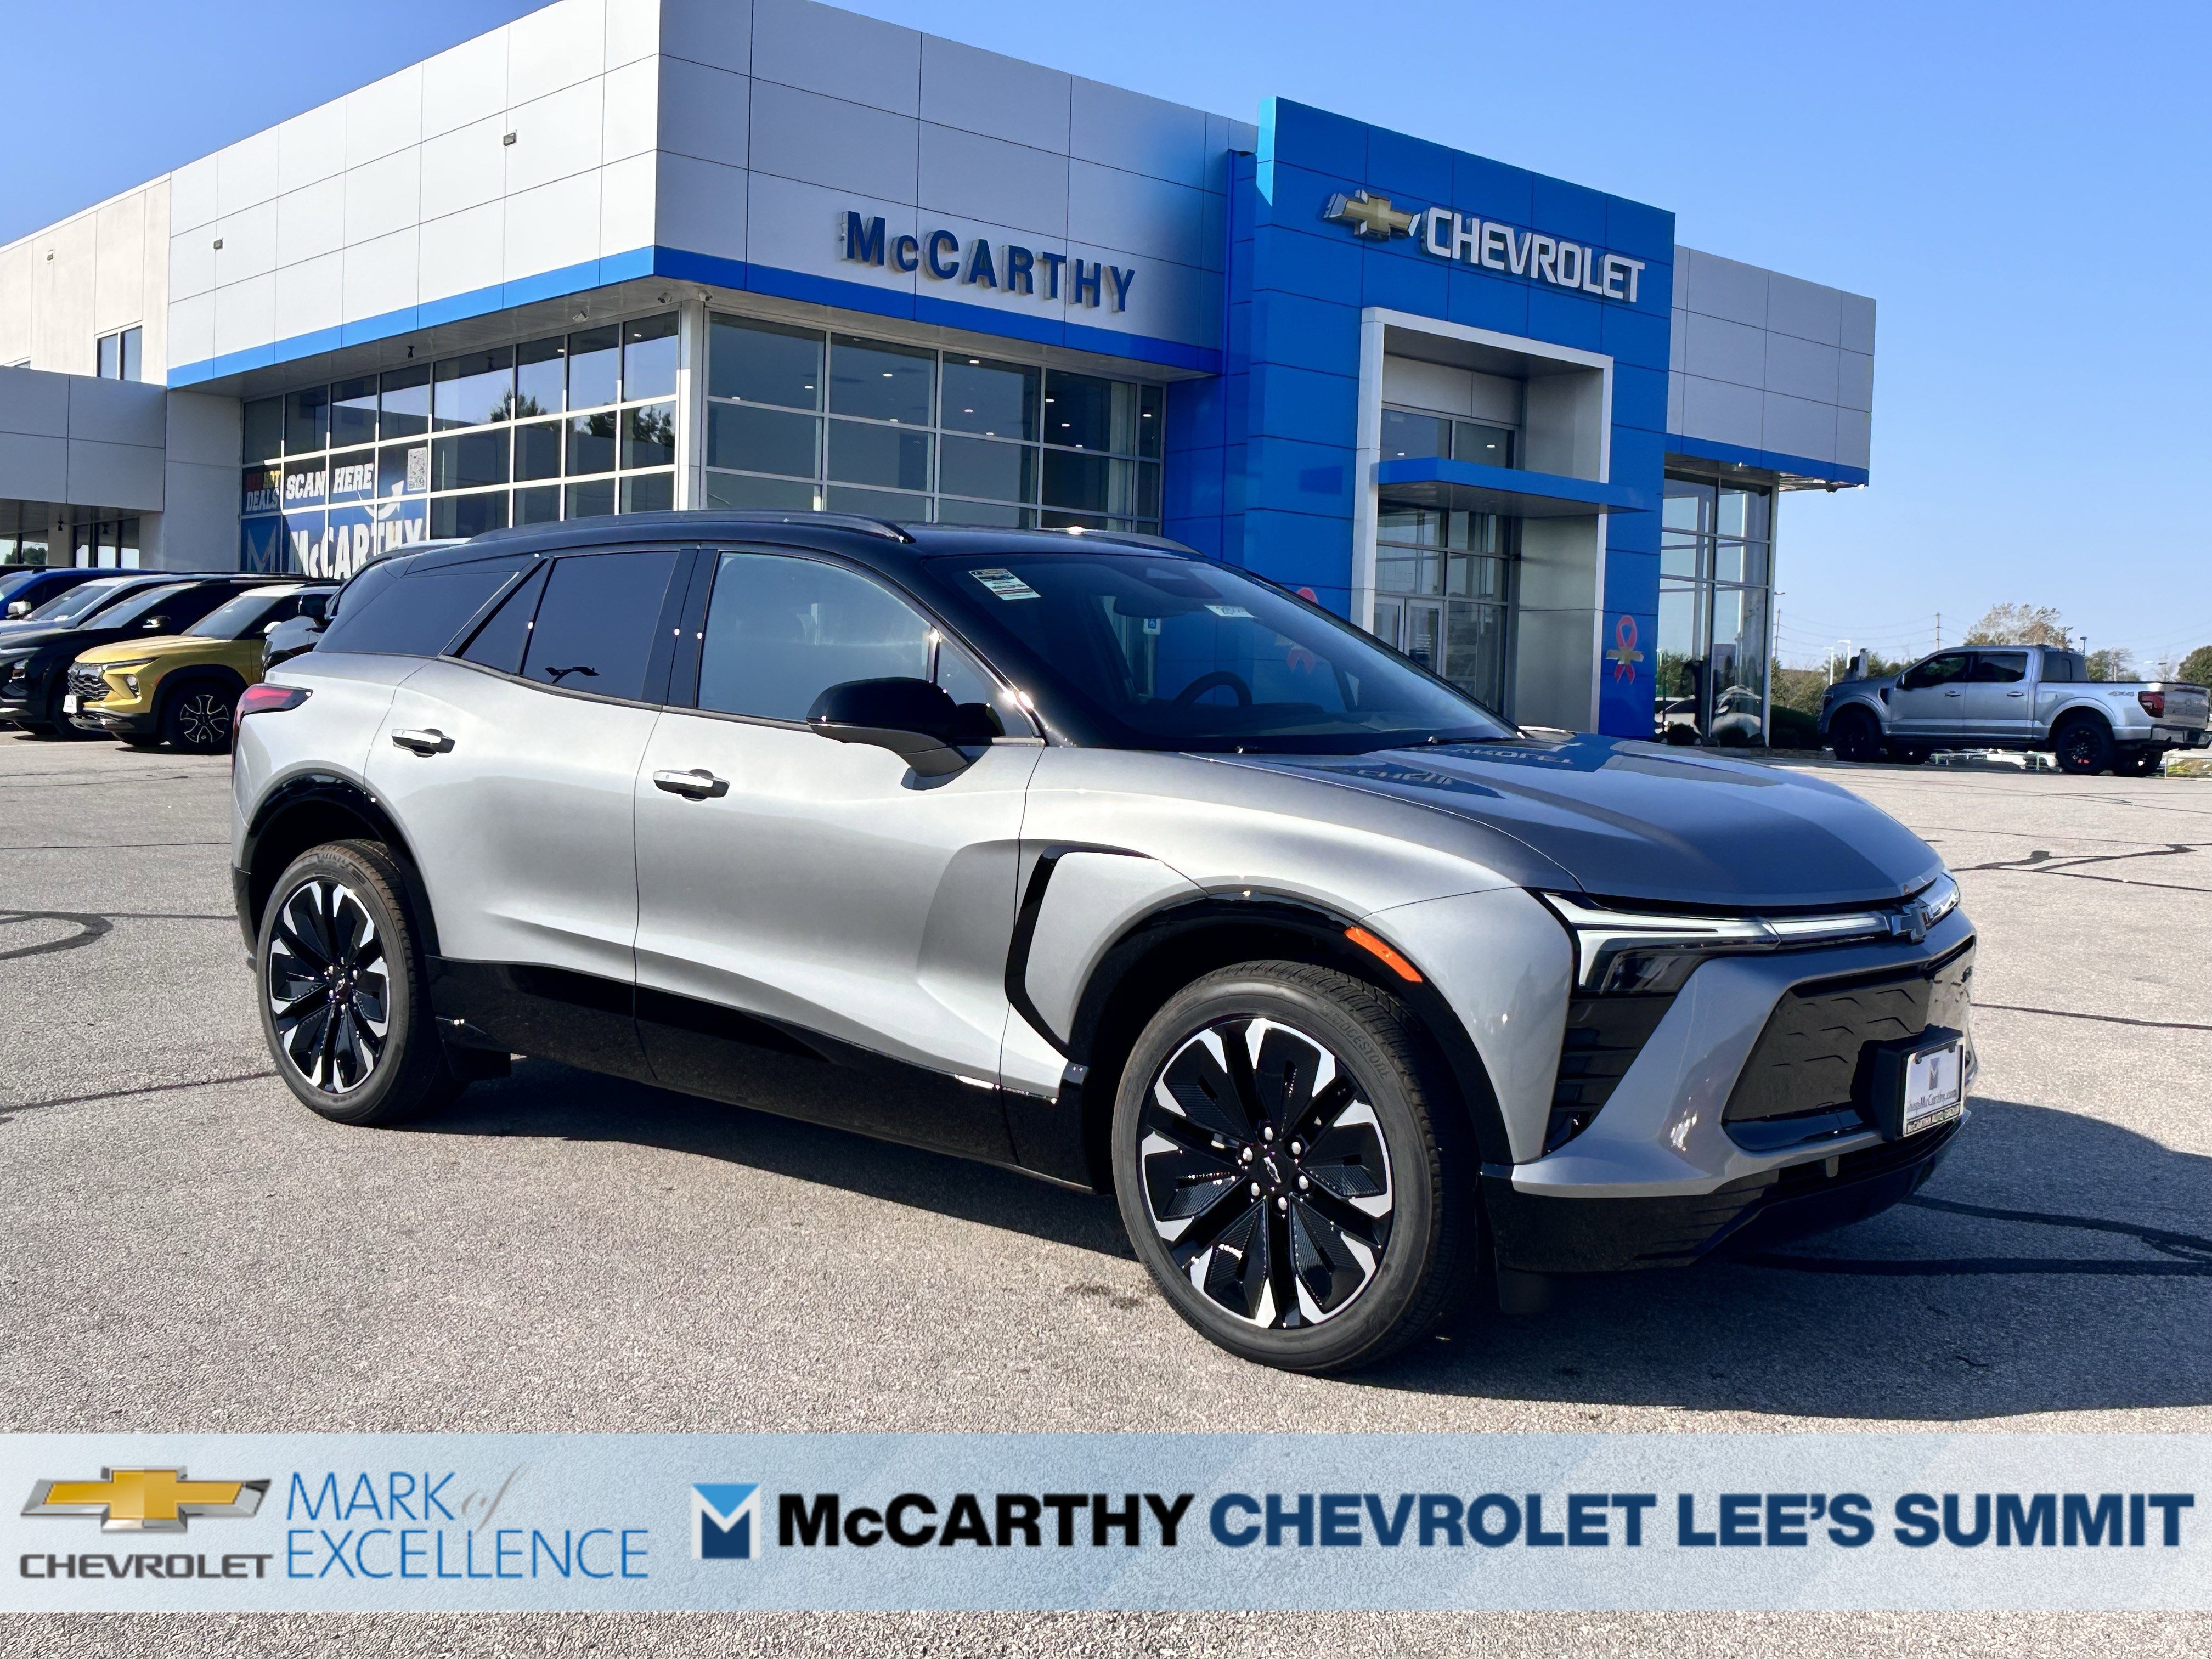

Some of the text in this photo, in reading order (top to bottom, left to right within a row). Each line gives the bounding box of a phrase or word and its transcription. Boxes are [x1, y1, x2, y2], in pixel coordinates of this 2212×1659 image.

[842, 211, 1135, 313] McCARTHY
[1425, 206, 1645, 303] CHEVROLET
[246, 488, 280, 512] DEALS
[286, 470, 326, 500] SCAN
[332, 462, 374, 493] HERE
